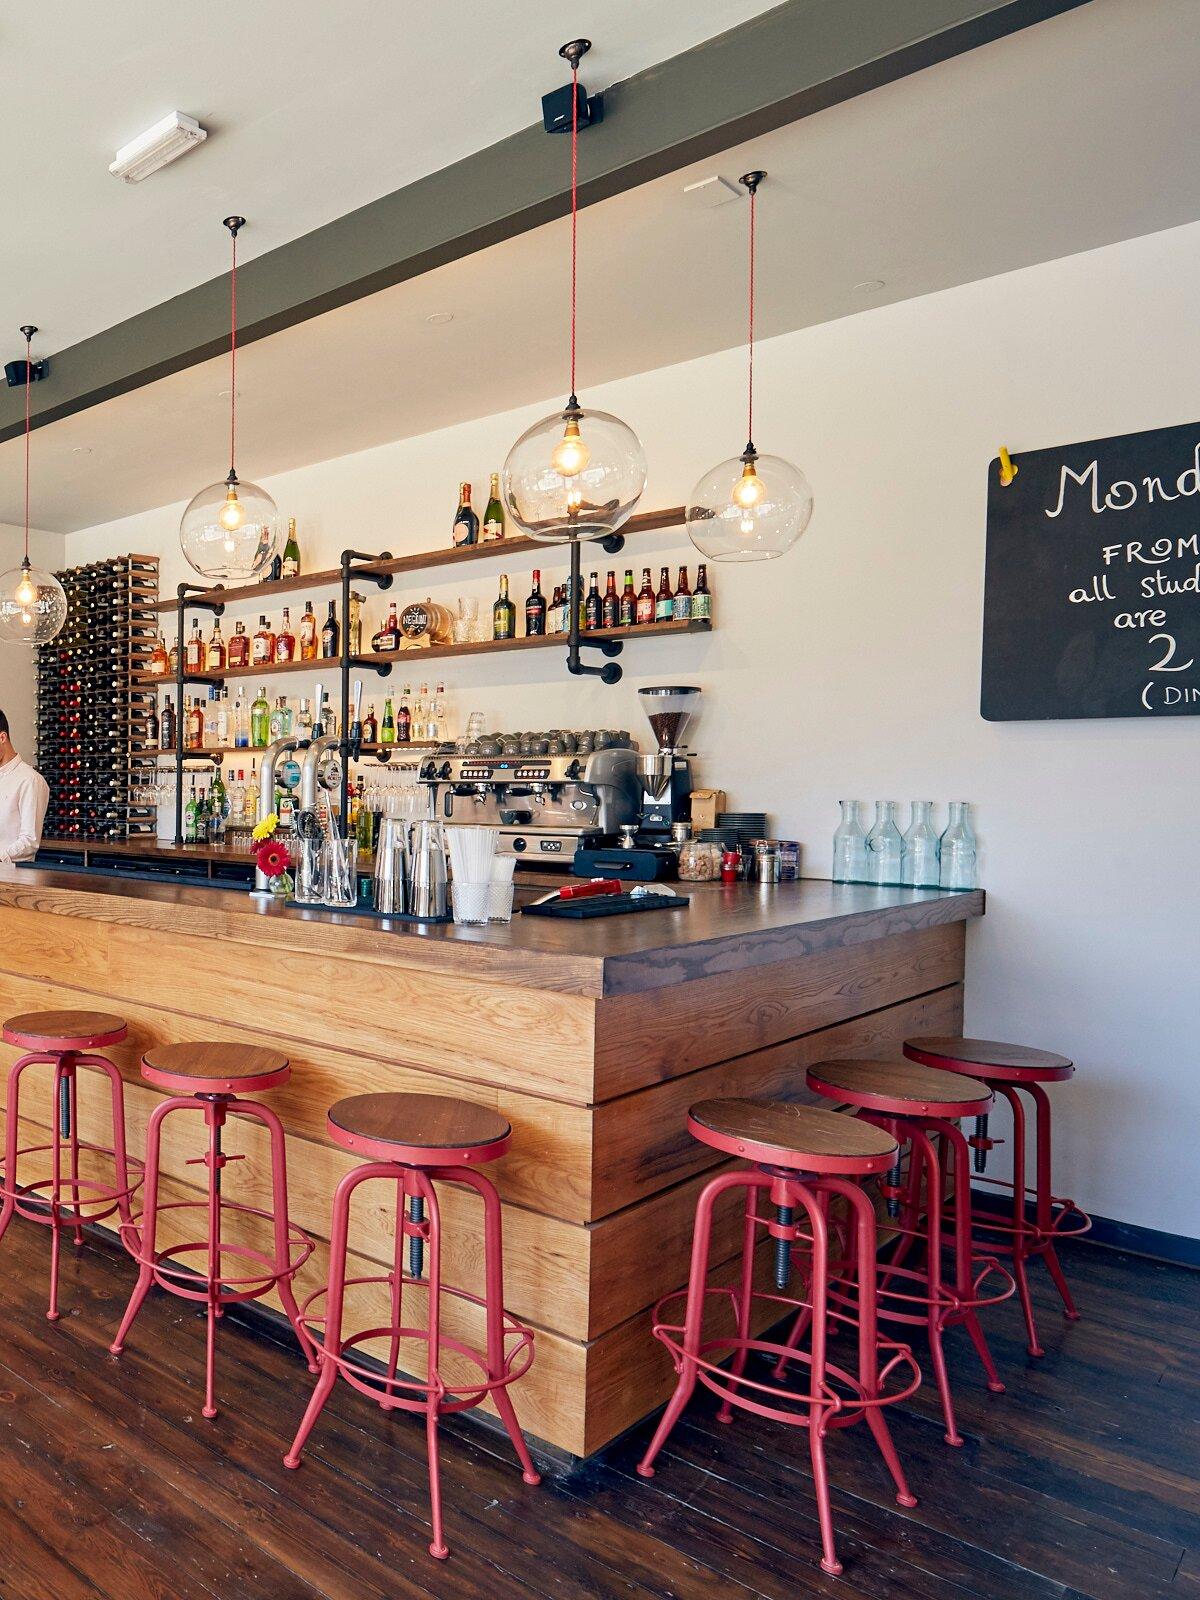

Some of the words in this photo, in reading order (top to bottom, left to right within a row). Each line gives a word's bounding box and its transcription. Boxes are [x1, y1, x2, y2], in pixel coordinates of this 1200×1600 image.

[1045, 442, 1200, 517] Mond
[1102, 533, 1200, 566] FROM
[1068, 575, 1117, 604] all
[1140, 562, 1200, 599] stud
[1113, 609, 1167, 629] are
[1148, 633, 1194, 673] 2
